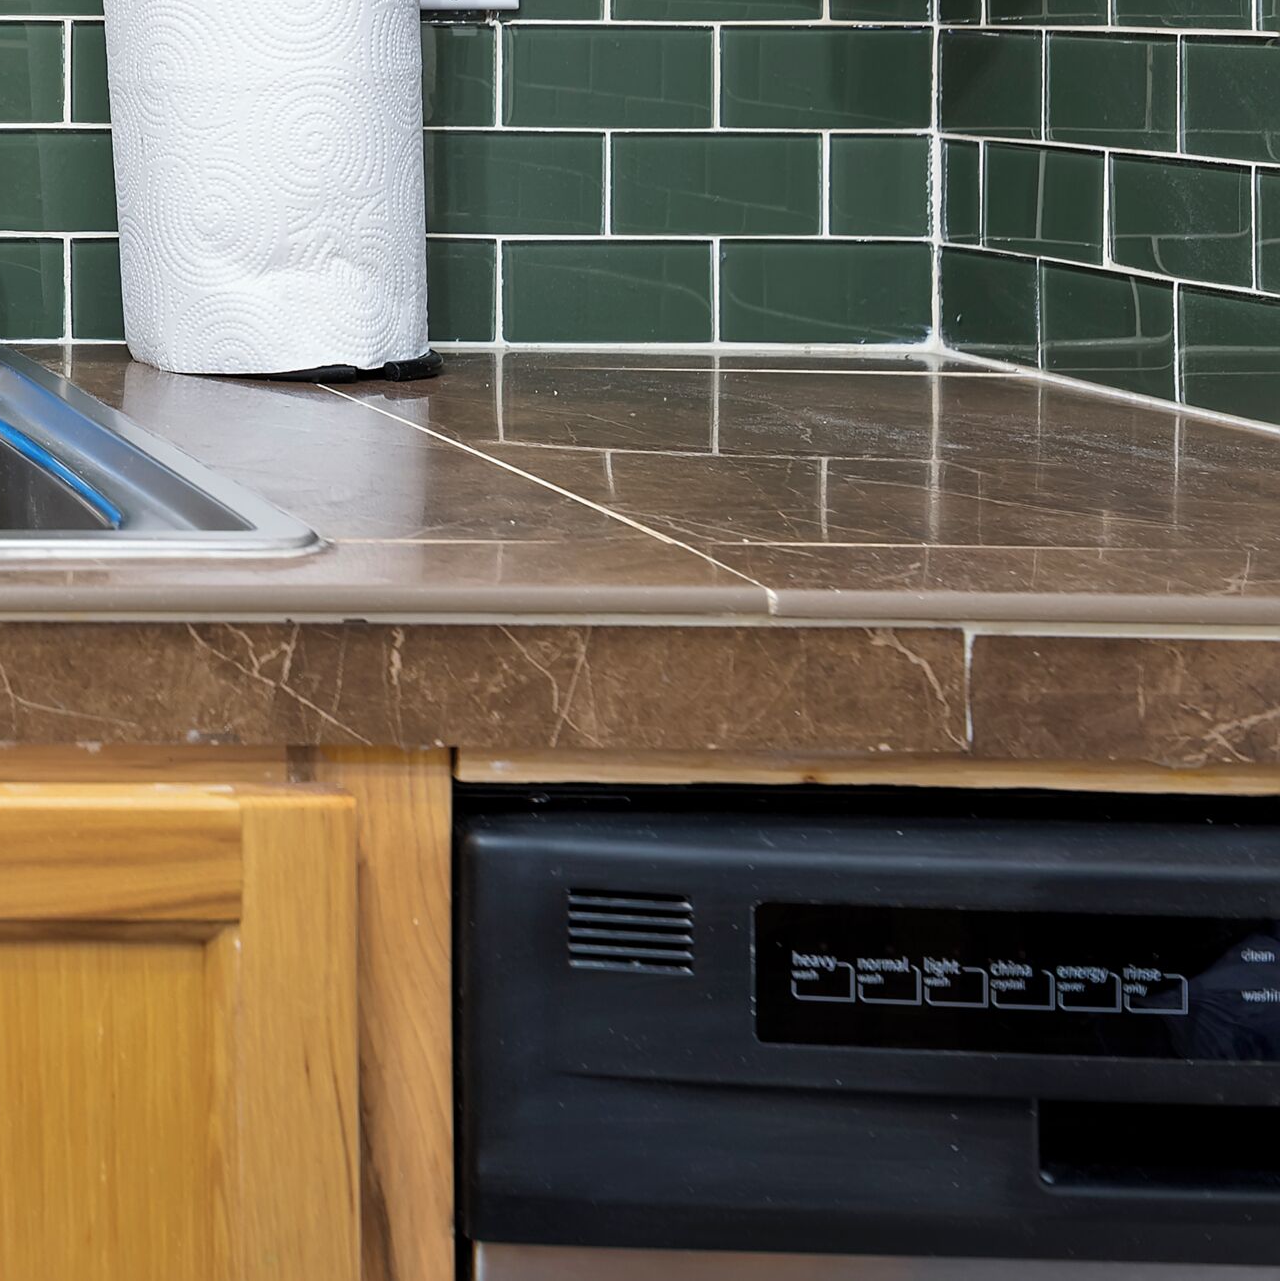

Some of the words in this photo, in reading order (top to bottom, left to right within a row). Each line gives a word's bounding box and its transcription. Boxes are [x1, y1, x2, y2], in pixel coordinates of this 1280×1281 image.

[791, 950, 837, 972] heavy
[1240, 948, 1275, 962] clean
[856, 956, 910, 973] normal
[923, 956, 961, 977] light
[989, 959, 1033, 977] china
[1122, 964, 1162, 982] rinse
[1056, 965, 1110, 983] energy
